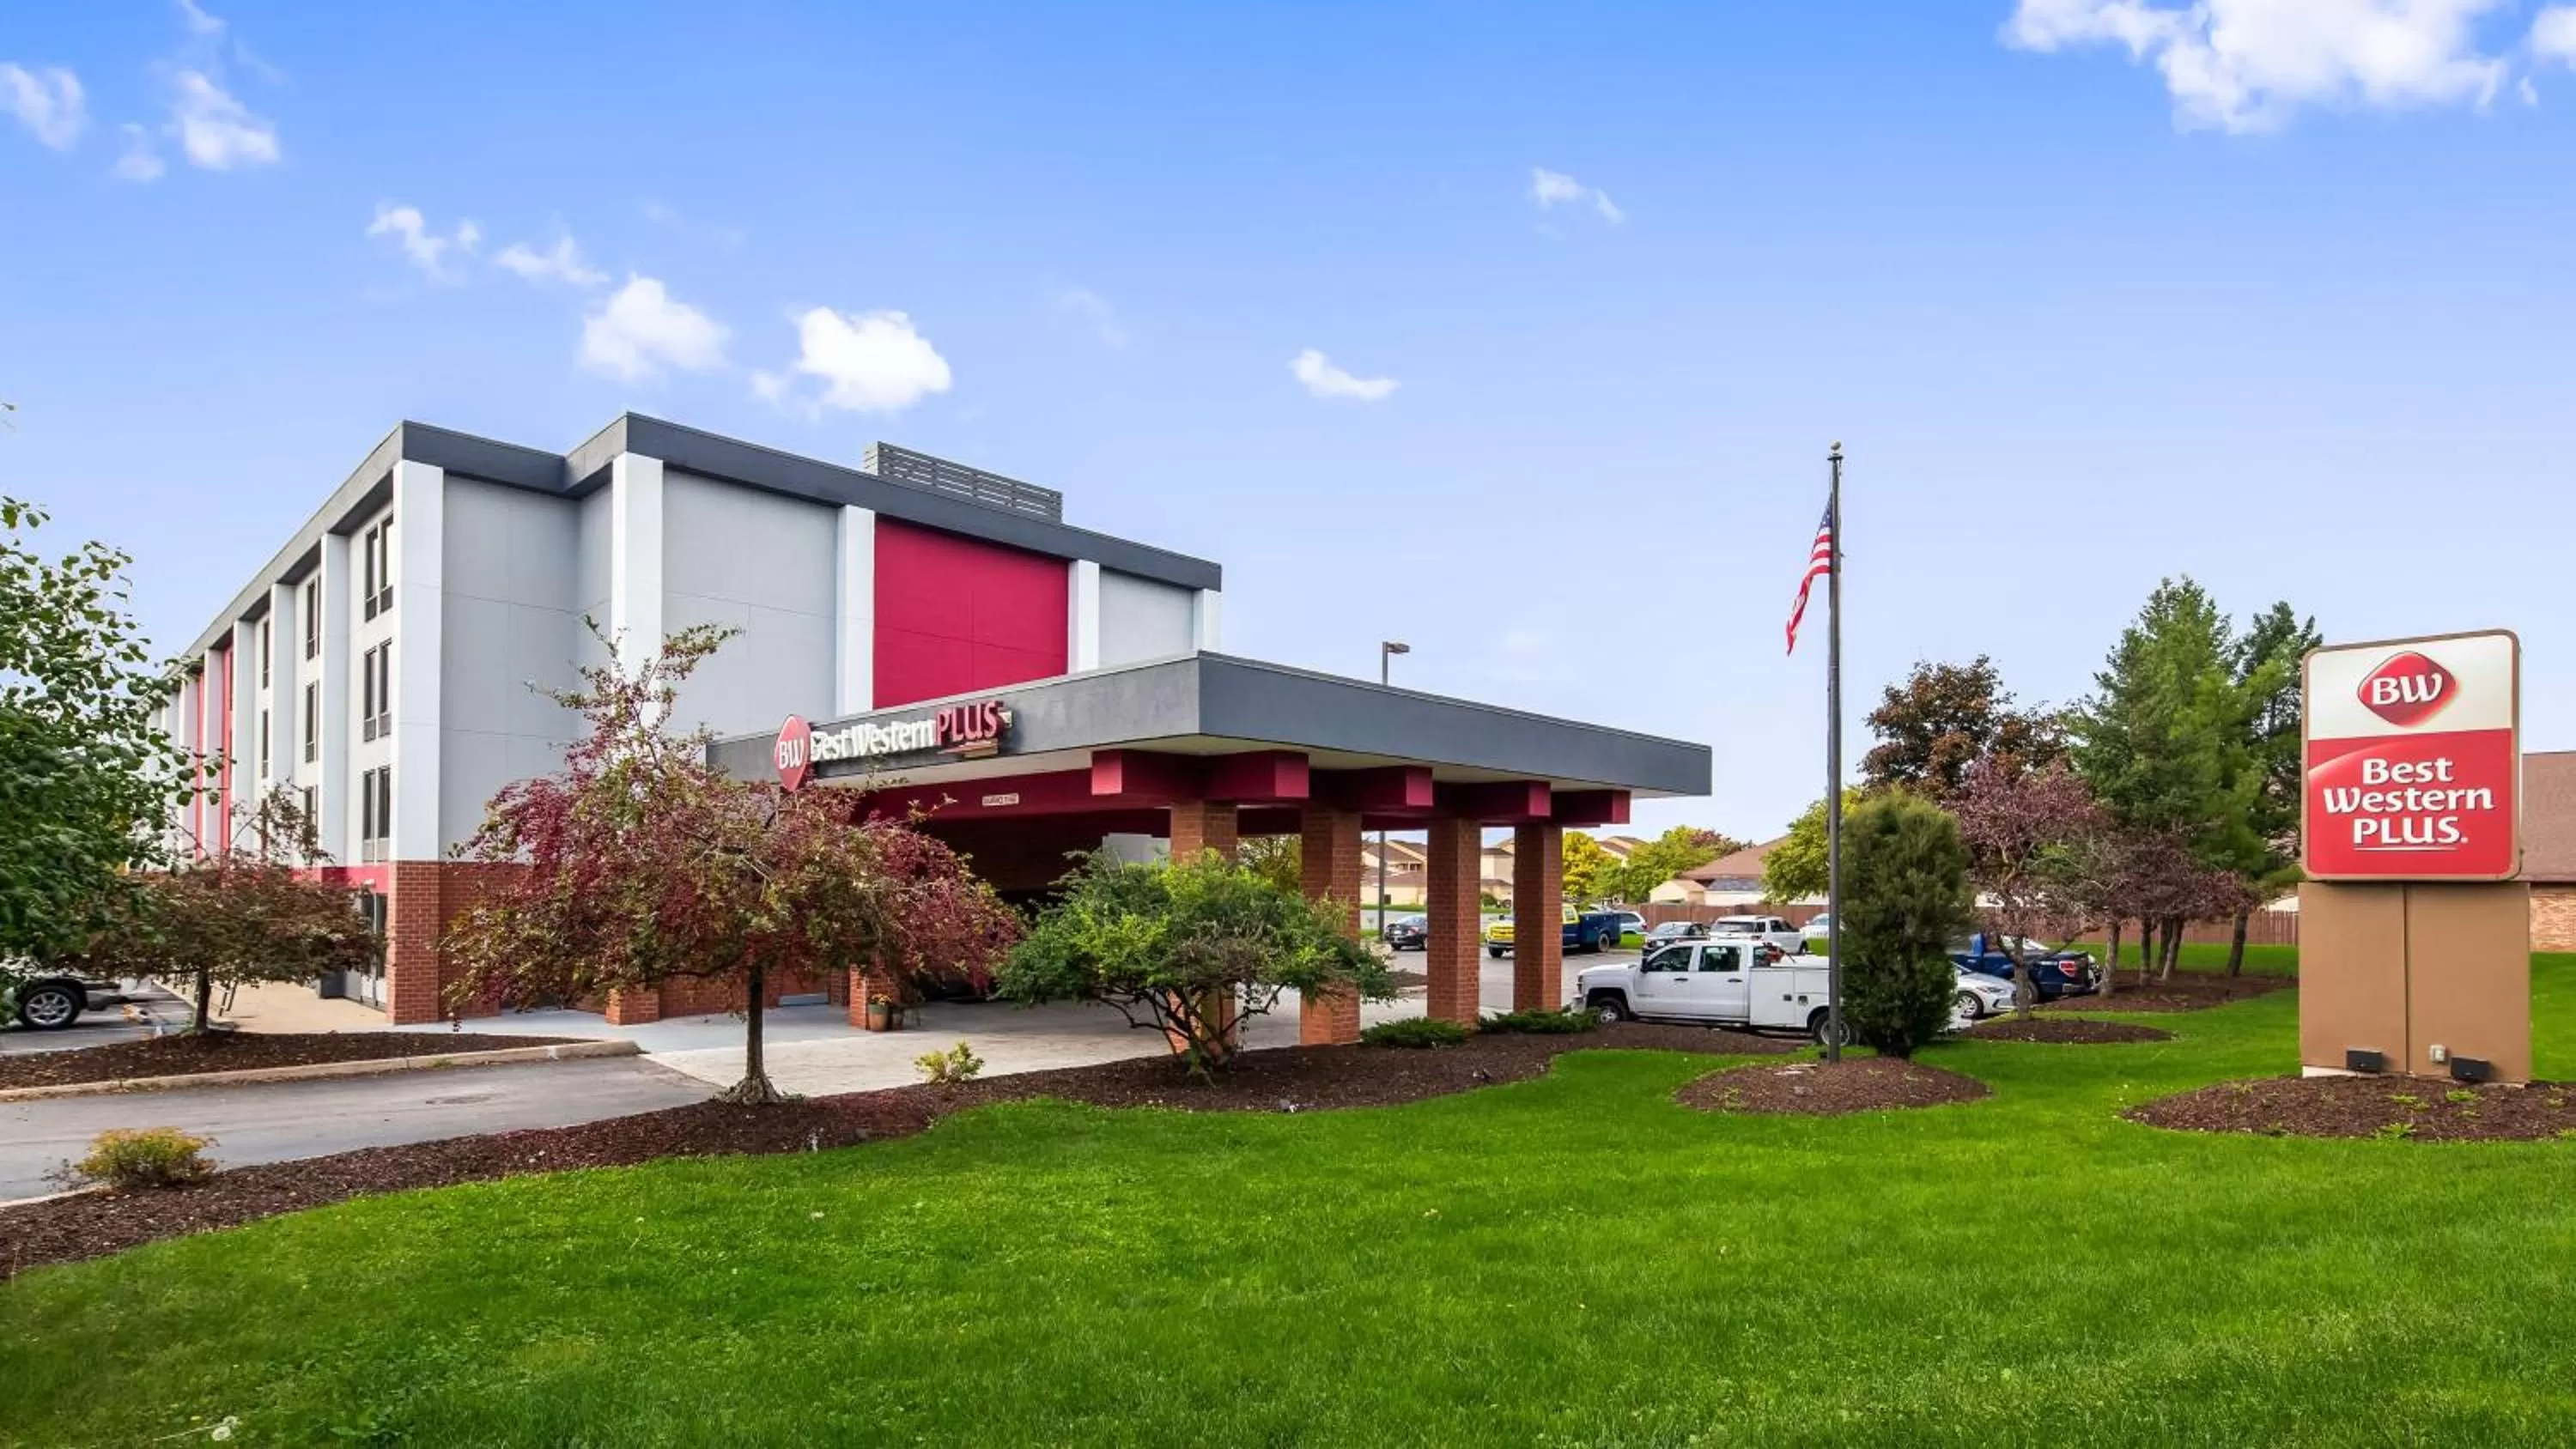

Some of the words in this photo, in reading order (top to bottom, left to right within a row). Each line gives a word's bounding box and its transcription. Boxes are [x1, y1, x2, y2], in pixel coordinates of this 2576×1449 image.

[2372, 673, 2443, 705] BW
[810, 731, 851, 762] Best
[851, 720, 935, 755] Western
[935, 701, 997, 746] PLUS
[779, 736, 805, 770] BW
[2363, 757, 2453, 785] Best
[2323, 787, 2494, 814] Western
